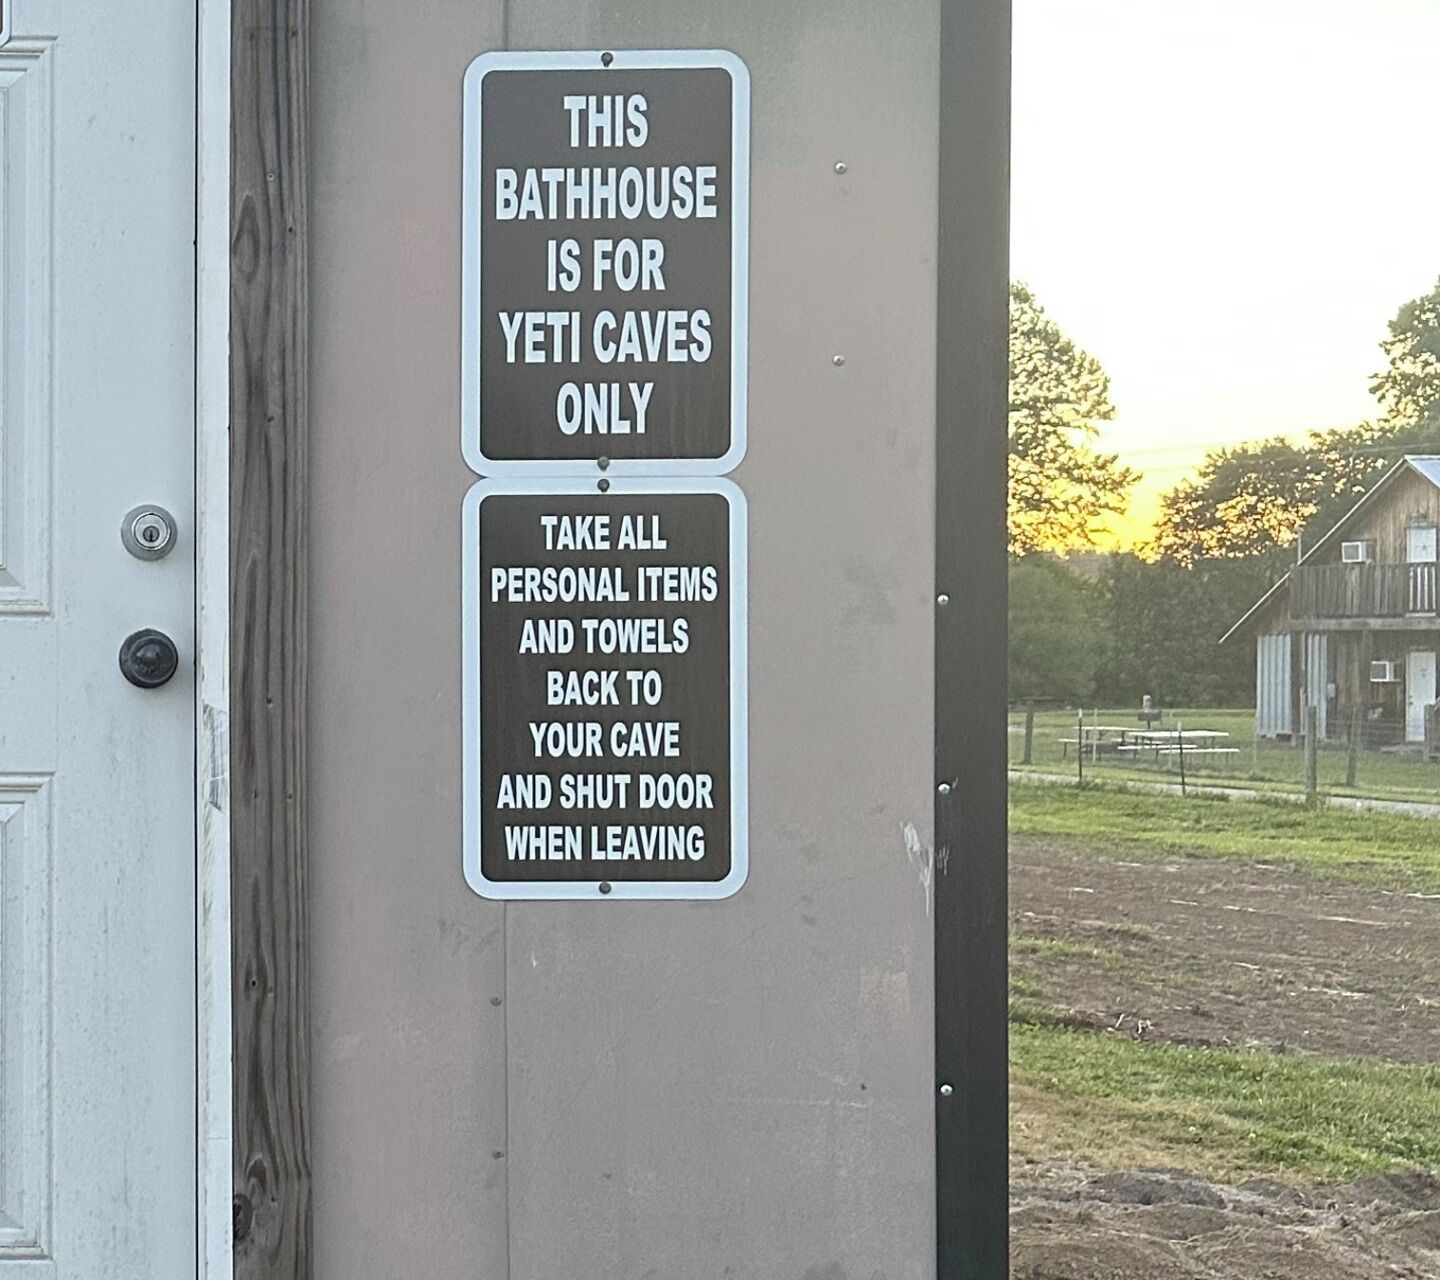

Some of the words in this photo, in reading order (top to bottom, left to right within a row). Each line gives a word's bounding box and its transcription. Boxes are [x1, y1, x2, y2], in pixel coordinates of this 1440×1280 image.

[563, 94, 648, 147] THIS
[496, 166, 717, 220] BATHHOUSE
[547, 239, 581, 292] IS
[593, 238, 665, 291] FOR
[499, 311, 580, 363] YETI
[593, 310, 712, 363] CAVES
[556, 382, 654, 435] ONLY
[541, 515, 610, 550] TAKE
[618, 515, 667, 549] ALL
[491, 567, 629, 602] PERSONAL
[638, 566, 718, 601] ITEMS
[519, 619, 574, 654] AND
[582, 618, 689, 654] TOWELS
[547, 671, 619, 705] BACK
[626, 670, 661, 705] TO
[529, 722, 602, 758] YOUR
[610, 722, 680, 757] CAVE
[497, 775, 551, 809] AND
[559, 774, 630, 809] SHUT
[639, 773, 713, 809] DOOR
[505, 826, 583, 860] WHEN
[591, 825, 705, 860] LEAVING
